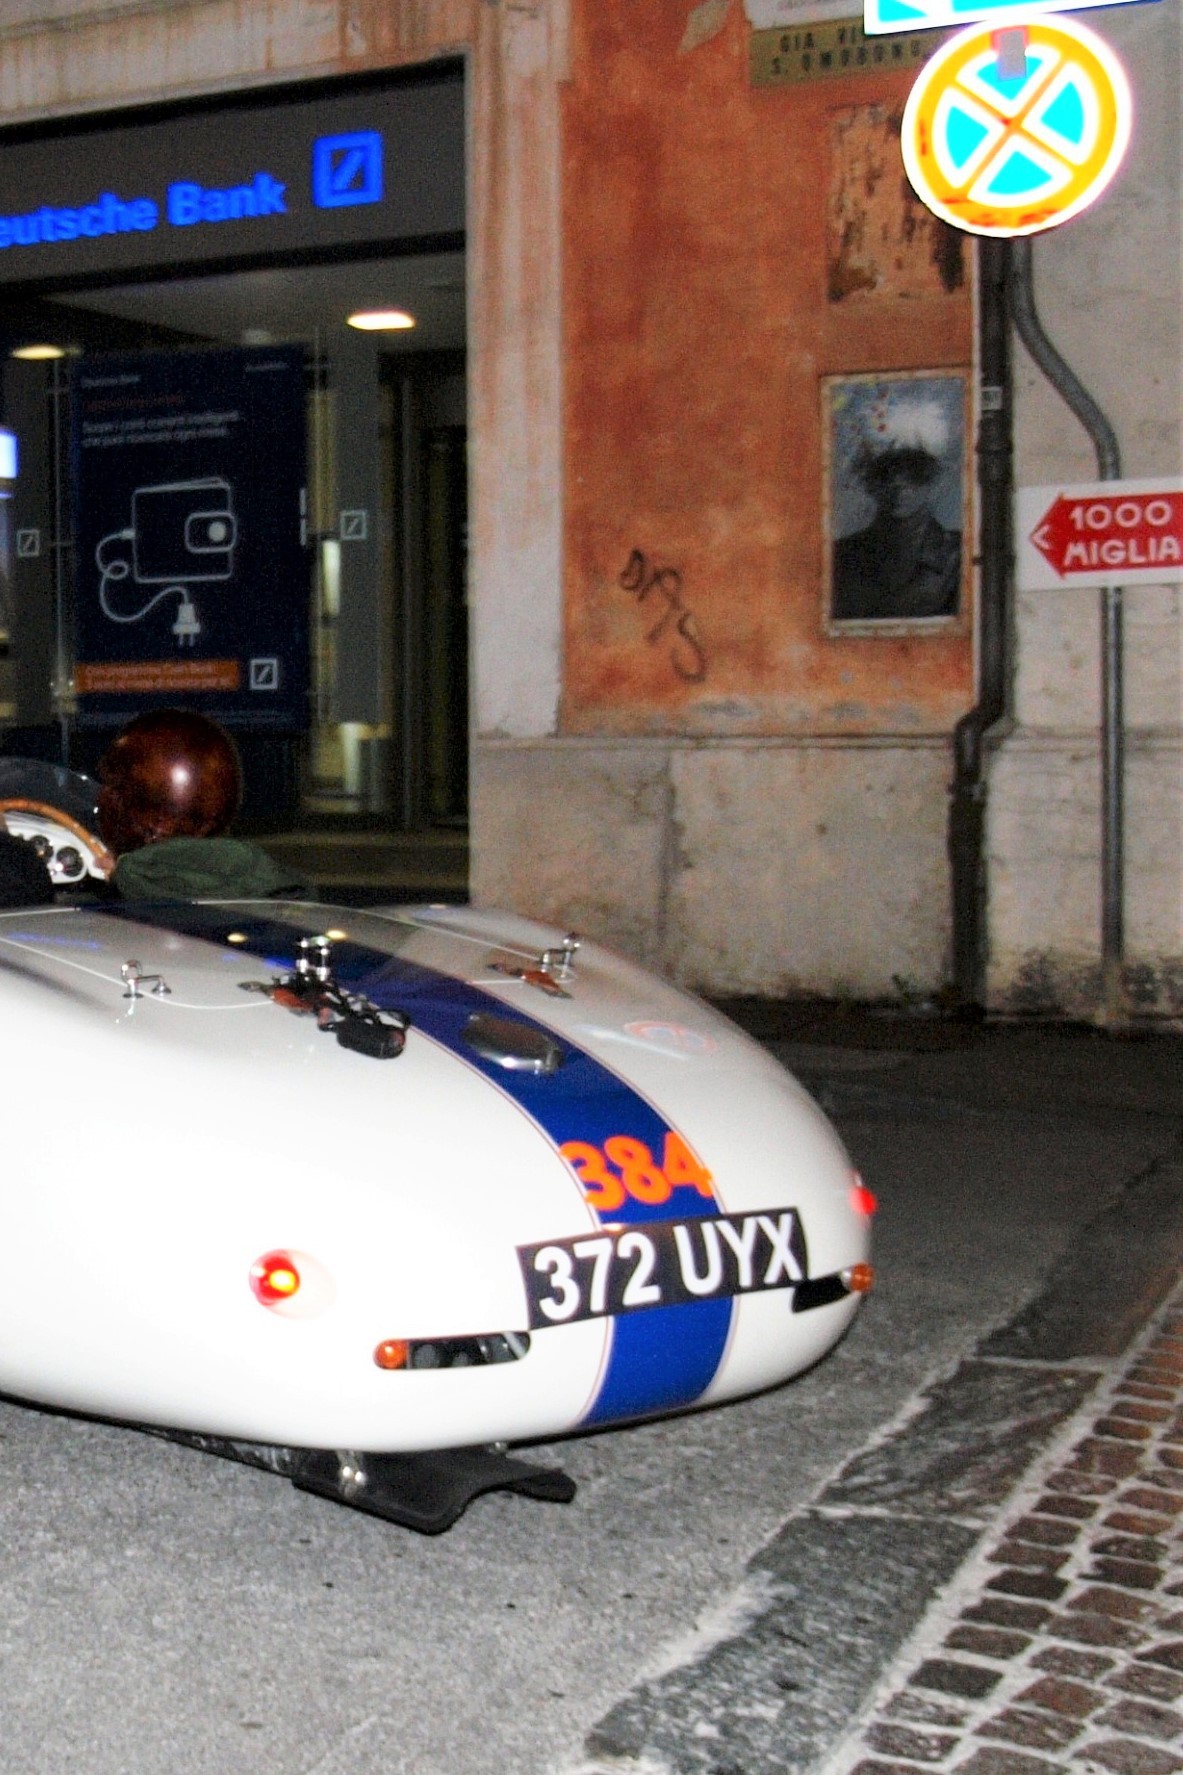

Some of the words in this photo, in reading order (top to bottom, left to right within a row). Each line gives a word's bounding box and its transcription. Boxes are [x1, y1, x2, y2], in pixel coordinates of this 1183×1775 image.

[167, 171, 287, 227] Bank
[1068, 500, 1173, 531] 1000
[1063, 535, 1181, 567] MIGLIA
[559, 1130, 716, 1212] 384
[533, 1232, 662, 1320] 372
[673, 1213, 804, 1296] UYX
